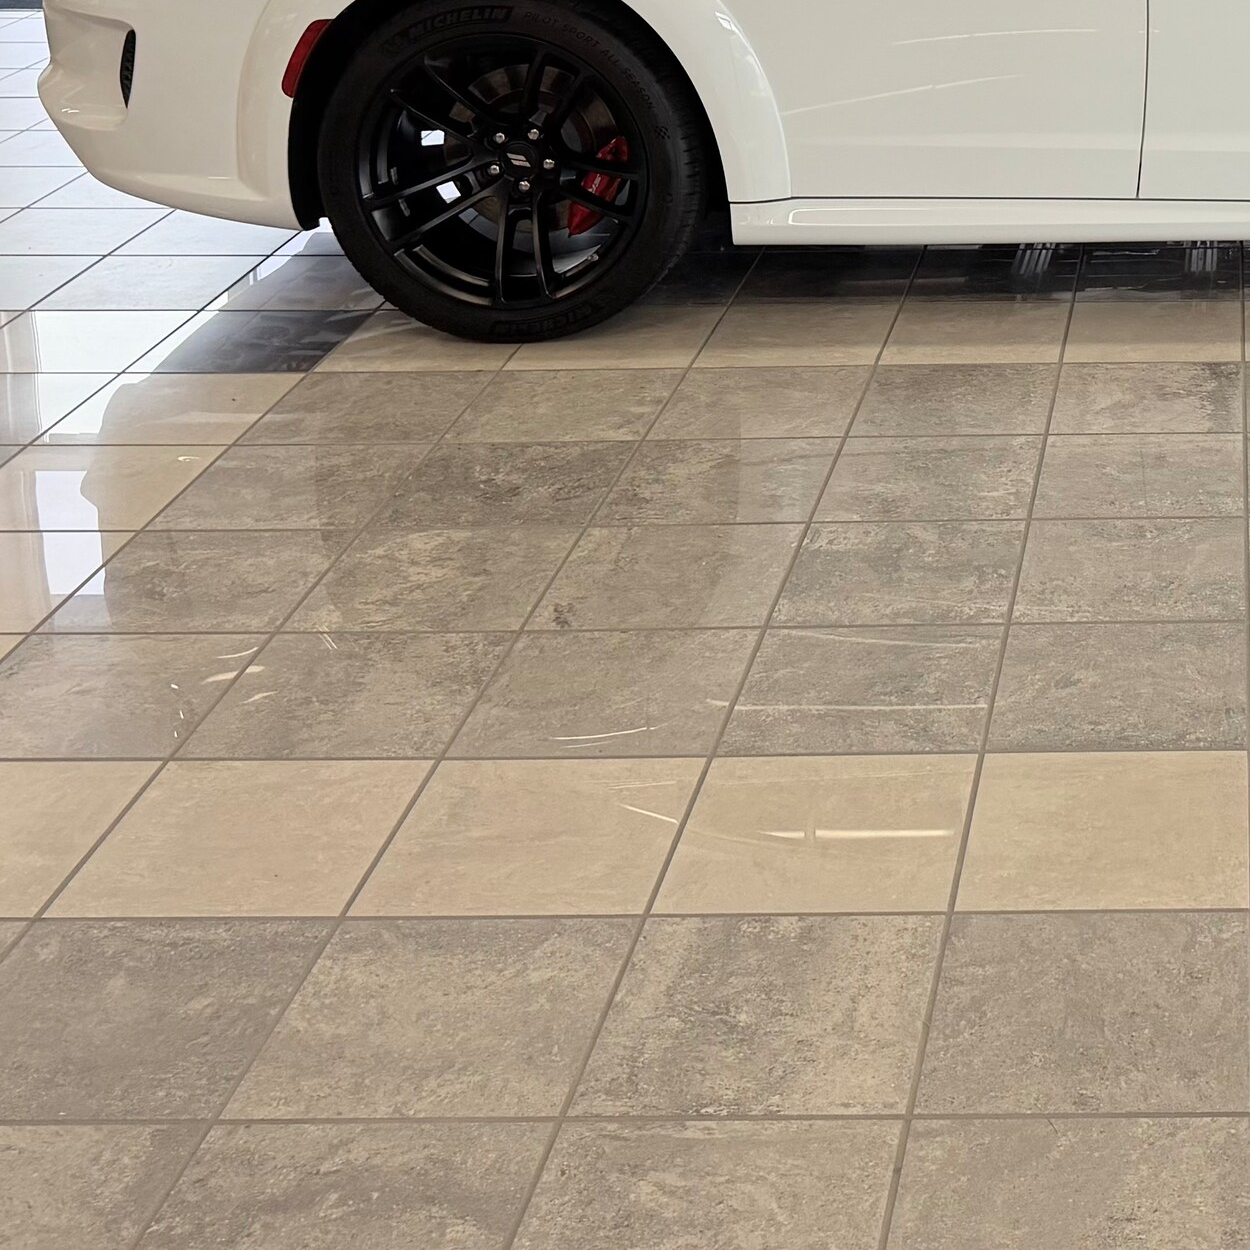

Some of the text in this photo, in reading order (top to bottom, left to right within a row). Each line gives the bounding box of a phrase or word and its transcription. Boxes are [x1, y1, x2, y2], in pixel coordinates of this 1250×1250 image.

[409, 6, 510, 39] MICHELIN
[524, 11, 558, 27] PILOT
[561, 23, 600, 49] SPORT
[621, 67, 656, 110] SEASON
